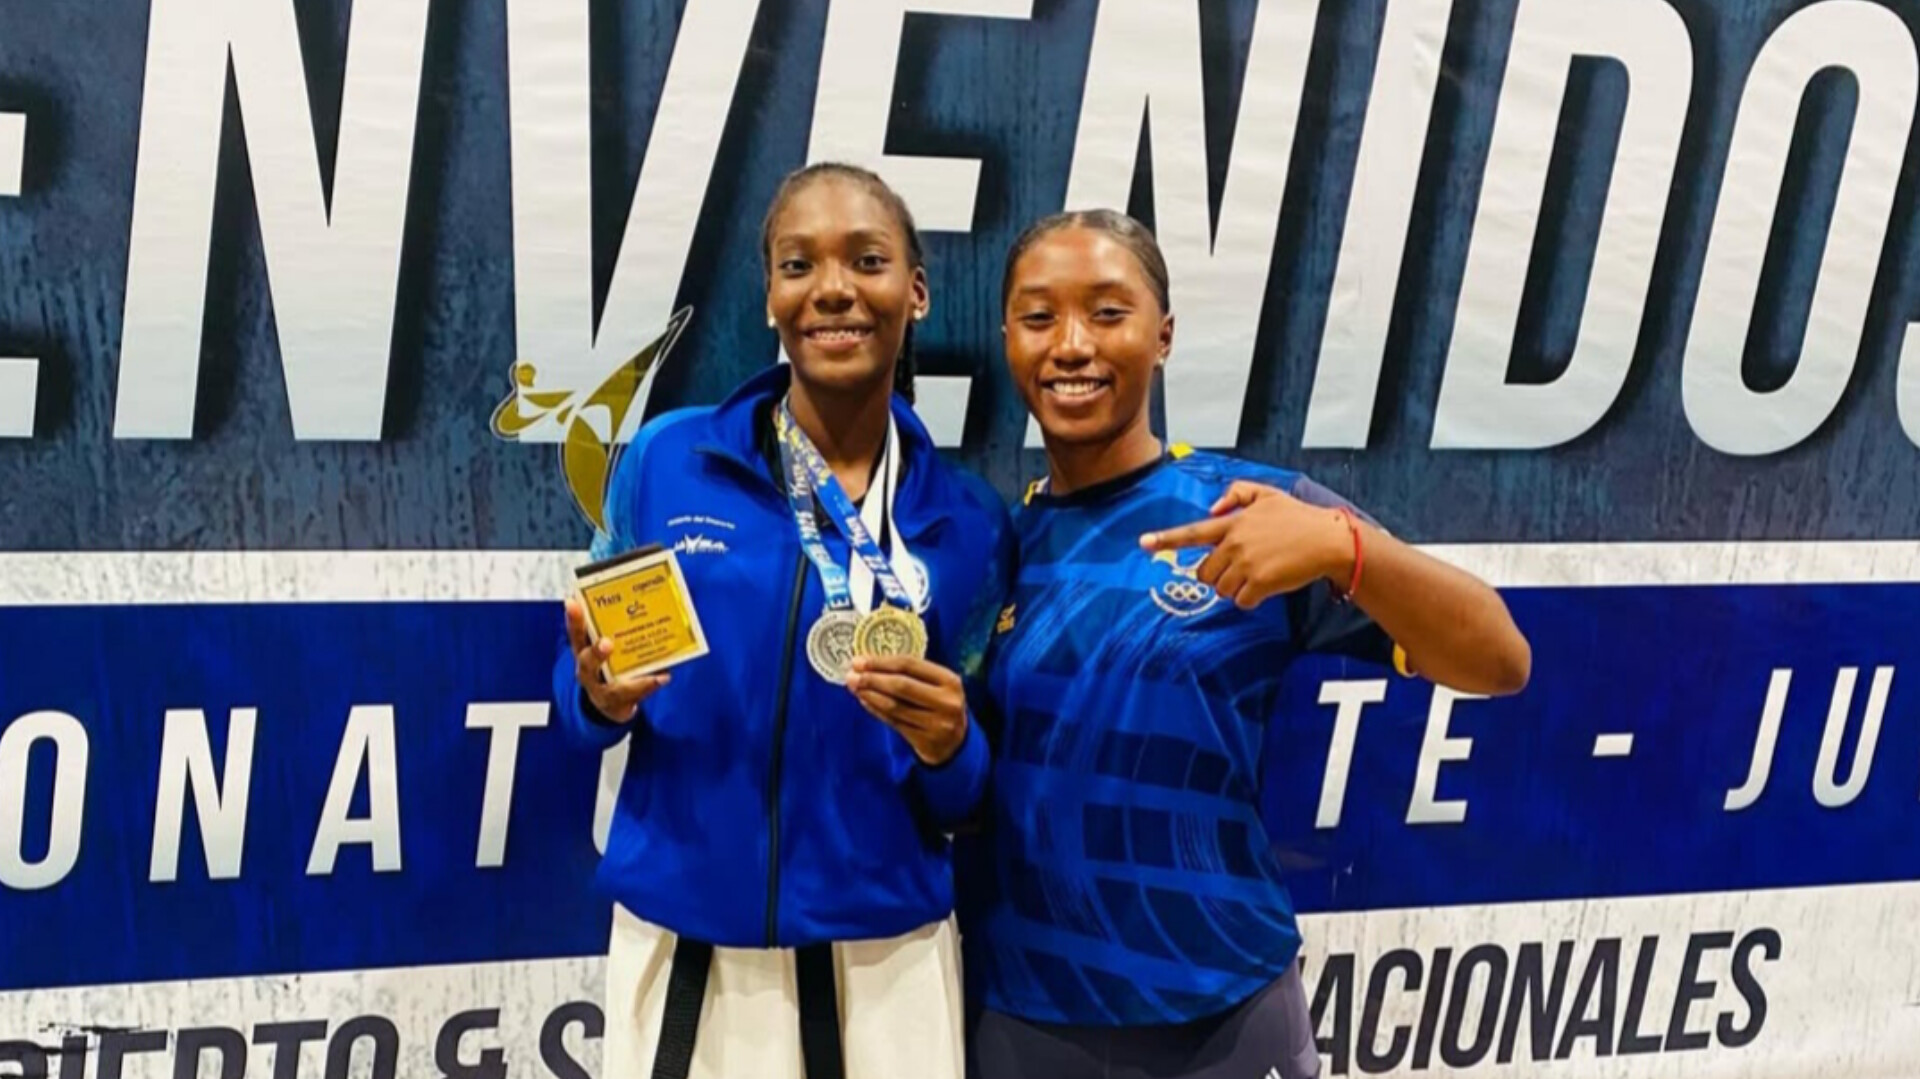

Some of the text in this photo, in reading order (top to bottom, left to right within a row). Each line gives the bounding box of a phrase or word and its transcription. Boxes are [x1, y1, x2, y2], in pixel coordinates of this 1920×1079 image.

[0, 0, 1920, 456] NVENIDO
[0, 701, 630, 890] ONAT
[1315, 678, 1490, 829] TE
[1298, 927, 1783, 1077] ACIONALES
